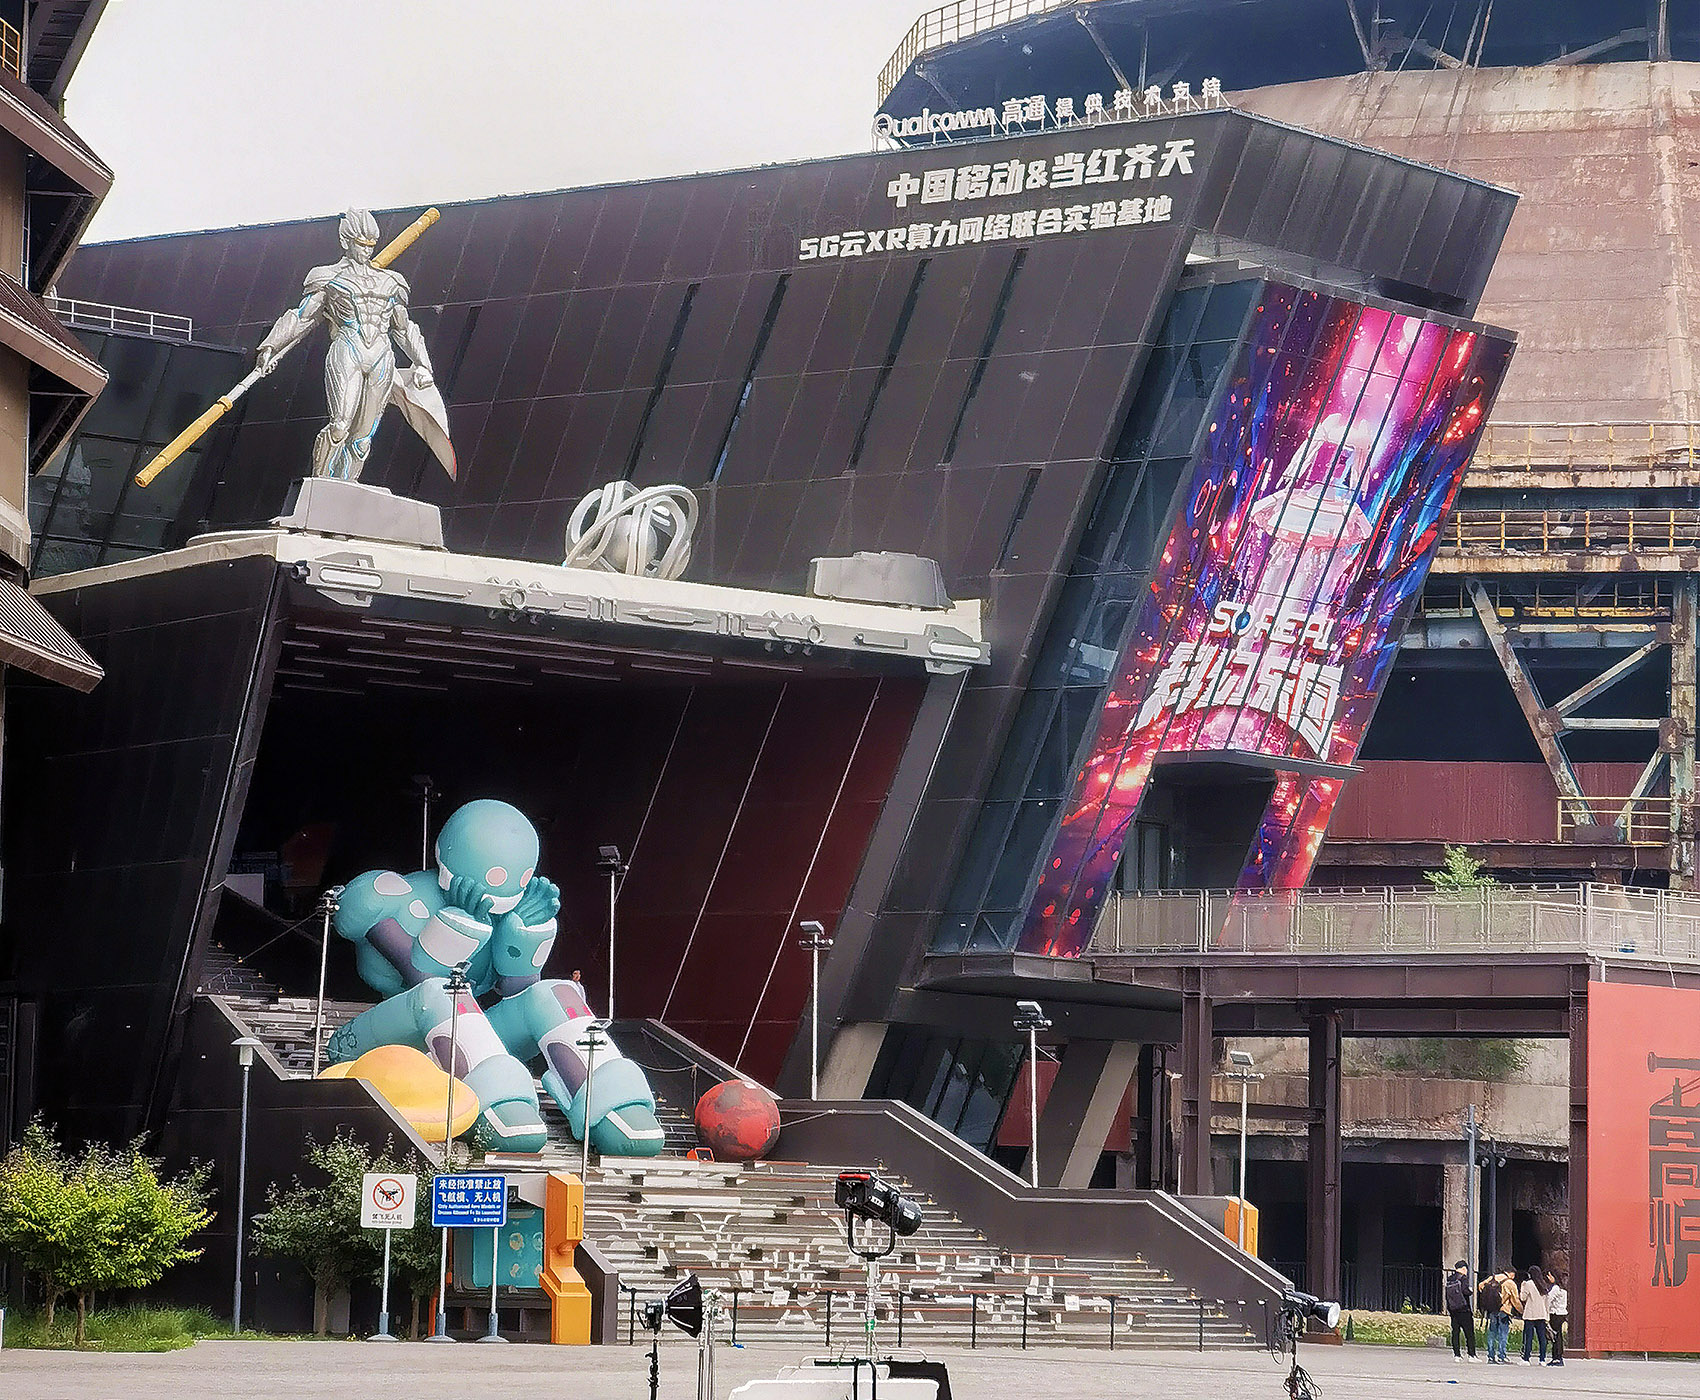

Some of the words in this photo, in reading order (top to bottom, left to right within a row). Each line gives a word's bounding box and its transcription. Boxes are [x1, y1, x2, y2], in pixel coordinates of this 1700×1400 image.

[873, 107, 996, 138] Qualcomm
[1001, 94, 1046, 125] 高通
[887, 138, 1196, 208] 中国移动&当红齐天
[799, 194, 1173, 261] 5G云XR算力网络联合实验基地
[438, 1179, 502, 1190] 未经批准禁止放
